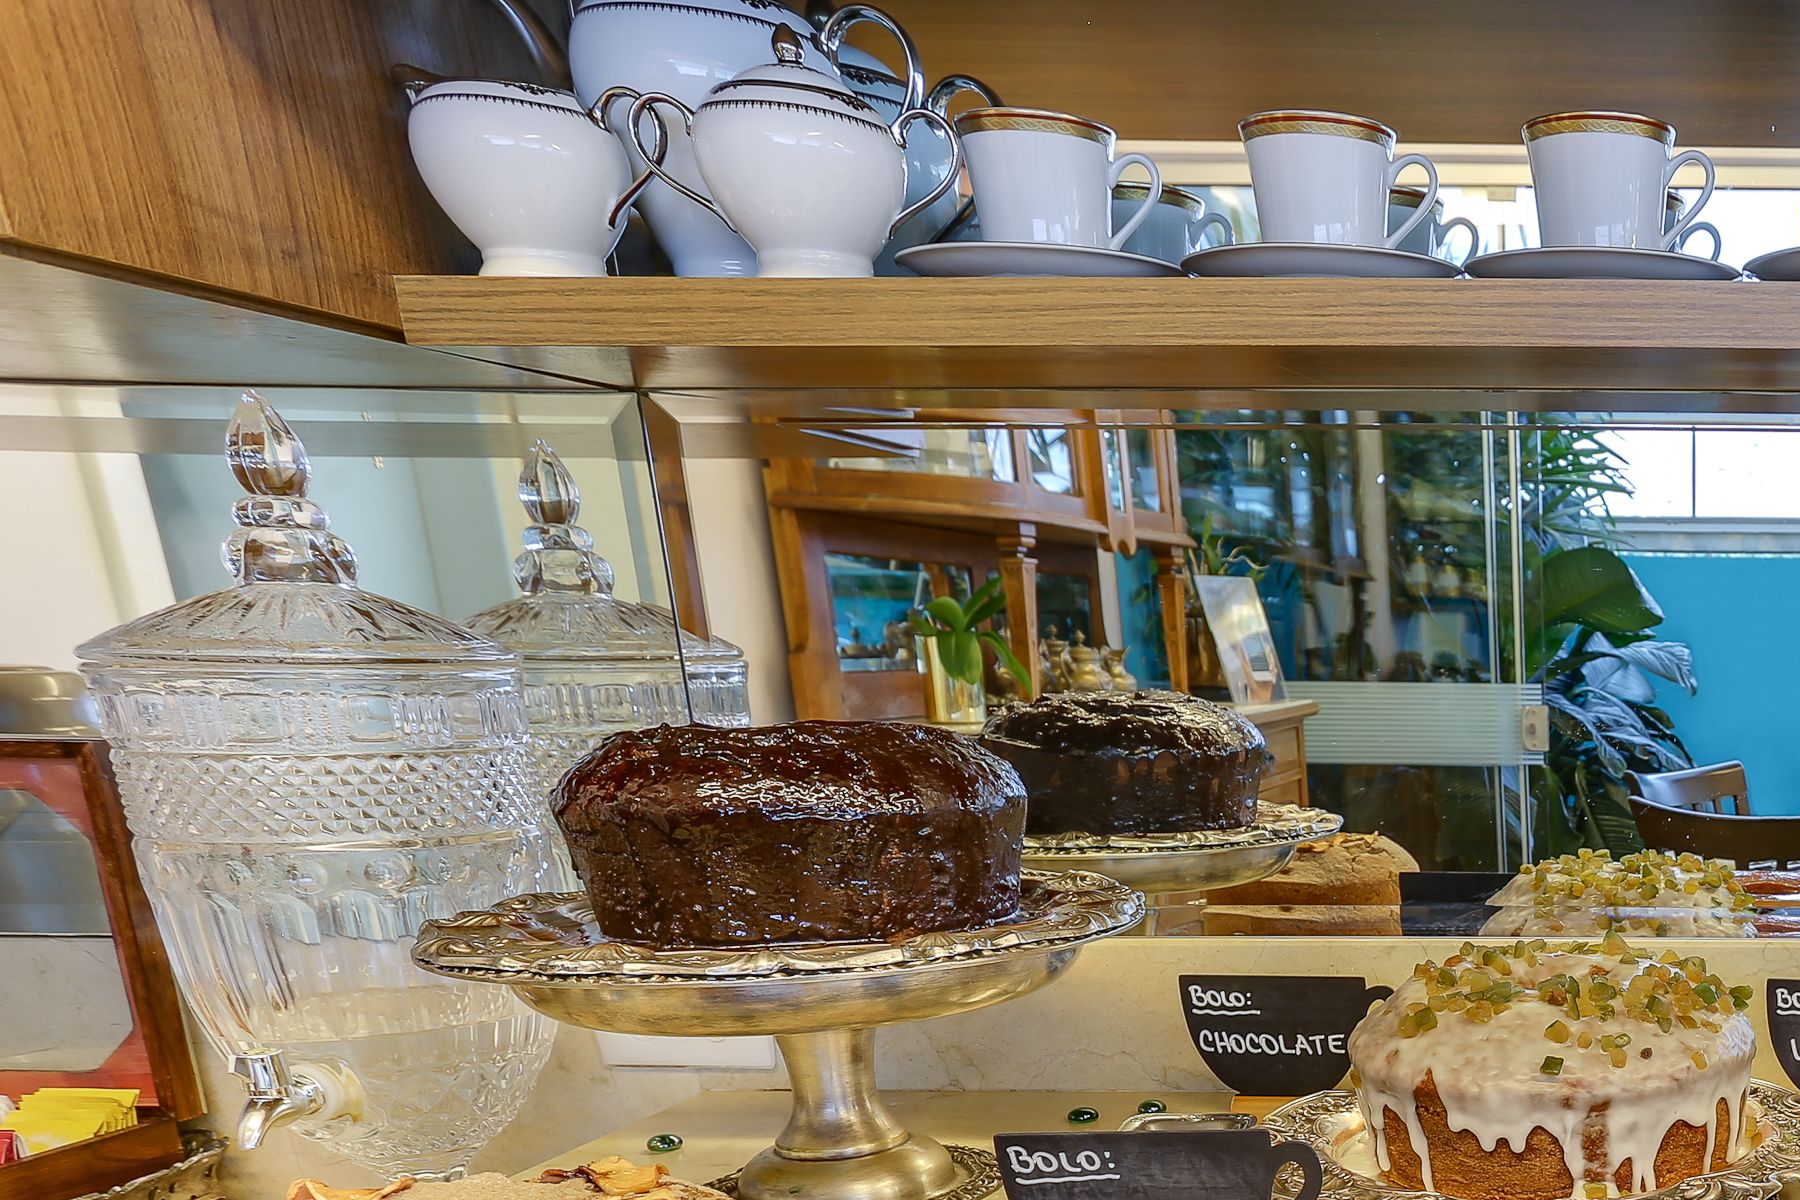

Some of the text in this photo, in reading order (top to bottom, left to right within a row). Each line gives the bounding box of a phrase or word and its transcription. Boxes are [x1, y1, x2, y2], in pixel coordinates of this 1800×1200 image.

[1187, 984, 1254, 1008] BOLO:
[1199, 1029, 1346, 1056] CHOCOLATE
[1005, 1145, 1117, 1174] BOLO:
